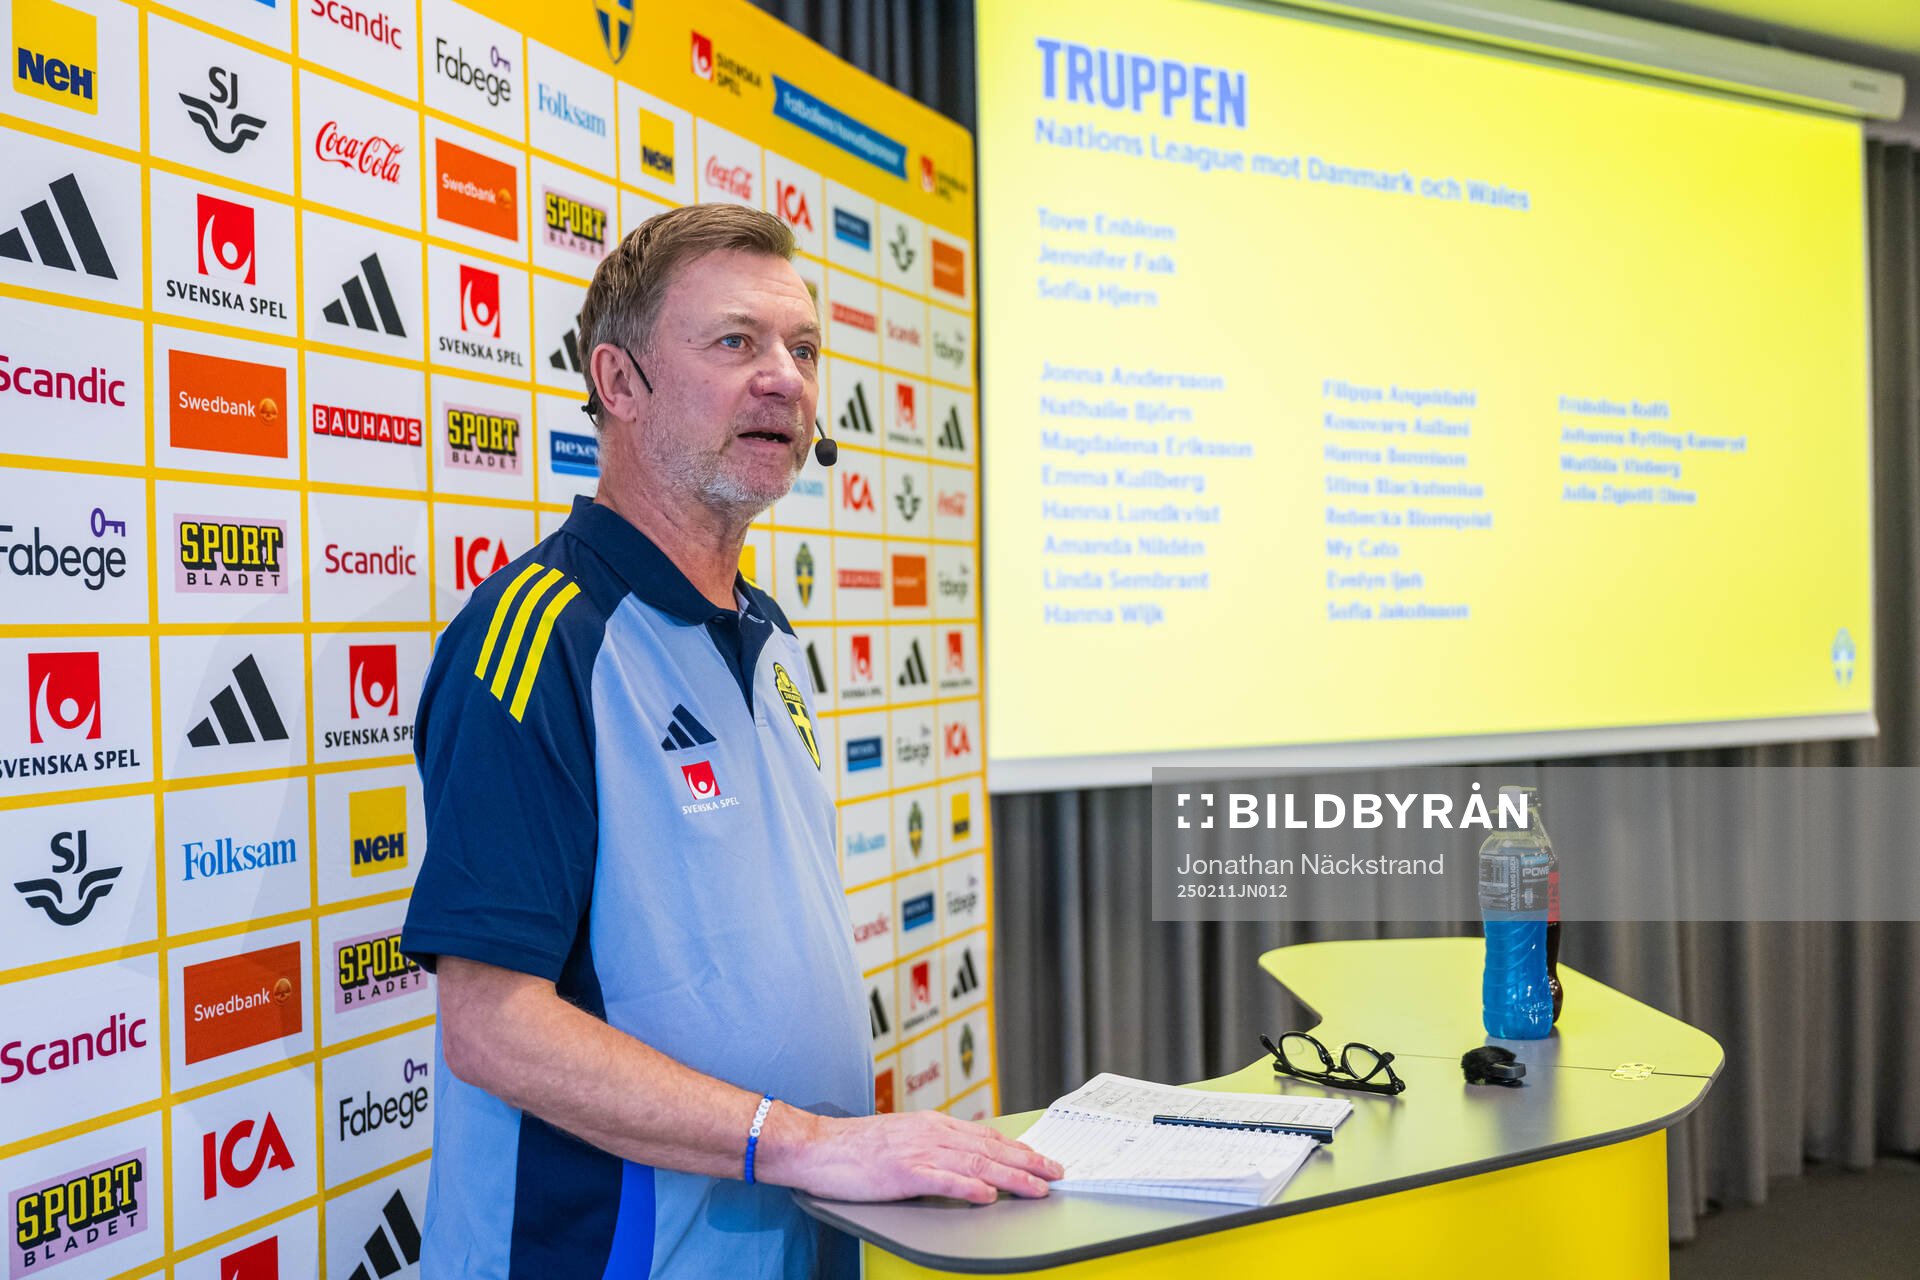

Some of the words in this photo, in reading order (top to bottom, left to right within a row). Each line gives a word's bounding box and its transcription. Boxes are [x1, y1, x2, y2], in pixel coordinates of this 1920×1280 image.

[208, 66, 238, 110] SJ
[435, 37, 511, 106] Fabege
[1036, 37, 1247, 128] TRUPPEN
[537, 82, 606, 137] Folksam
[315, 120, 405, 184] Coca-Cola
[1035, 118, 1143, 157] Nations
[1152, 135, 1244, 172] League
[1252, 154, 1301, 180] mot
[1307, 156, 1413, 195] Danmark
[1420, 178, 1461, 200] och
[1467, 180, 1530, 211] Wales
[442, 172, 497, 204] Swedbank
[776, 180, 813, 232] ICA
[545, 192, 607, 243] SPORT
[1037, 243, 1127, 270] Jennifer
[167, 279, 244, 311] SVENSKA
[250, 297, 288, 320] SPEL
[439, 336, 493, 360] SVENSKA
[497, 349, 523, 367] SPEL
[179, 391, 256, 418] Swedbank
[314, 405, 422, 443] BAUHAUS
[447, 409, 520, 457] SPORT
[451, 451, 517, 469] BLADET
[842, 471, 875, 513] ICA
[180, 522, 284, 573] SPORT
[325, 544, 417, 576] Scandic
[455, 536, 510, 590] ICA
[186, 572, 281, 587] BLADET
[94, 748, 140, 770] SPEL
[324, 727, 389, 748] SVENSKA
[682, 801, 720, 815] SVENSKA
[719, 796, 740, 808] SPEL
[50, 829, 87, 874] SJ
[181, 837, 297, 882] Folksam
[339, 933, 421, 991] SPOR
[194, 988, 271, 1022] Swedbank
[344, 973, 421, 1004] BLADET
[0, 1012, 147, 1084] Scandic
[339, 1085, 429, 1141] Fabege
[203, 1111, 296, 1201] ICA
[16, 1158, 142, 1250] SPORT
[23, 1212, 138, 1268] BLADET
